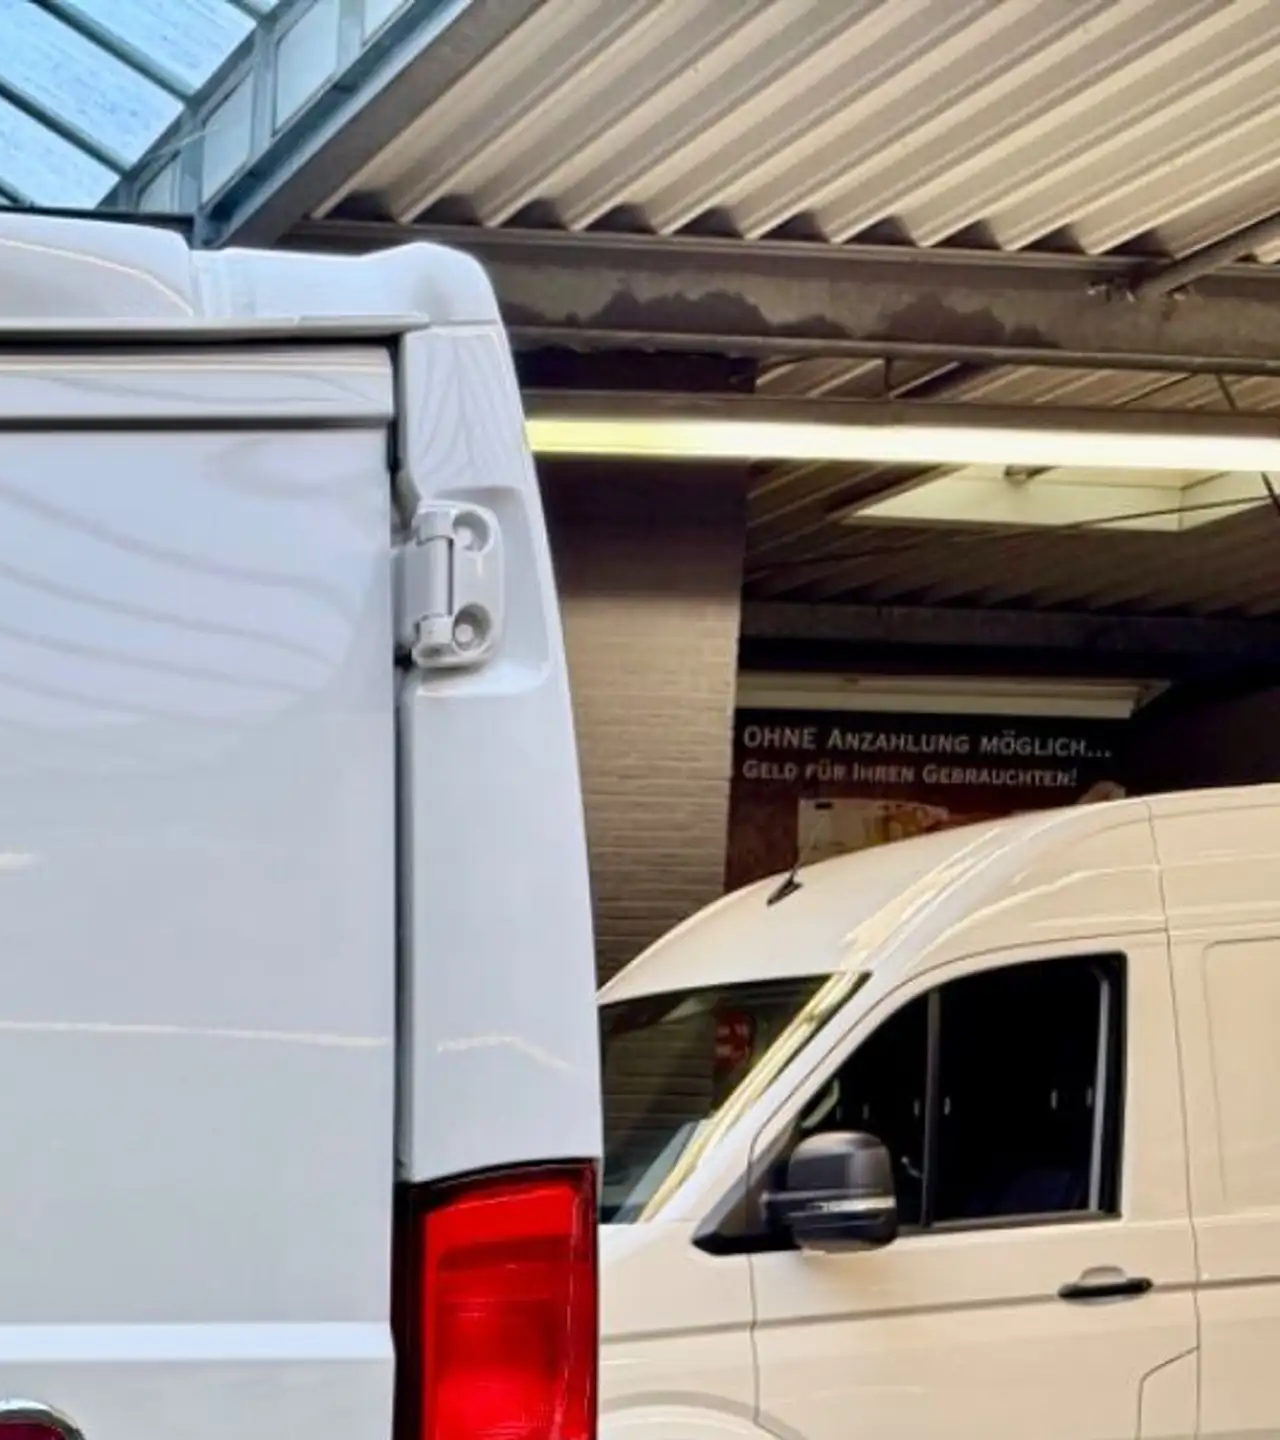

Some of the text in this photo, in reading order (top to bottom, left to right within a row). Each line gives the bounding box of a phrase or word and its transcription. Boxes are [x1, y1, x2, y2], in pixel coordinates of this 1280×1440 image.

[743, 725, 1113, 758] OHNE ANZAHLUNG MÖGLICH...
[742, 756, 1078, 787] GELD FÜR IHREN GEBRAUCHTEN!
